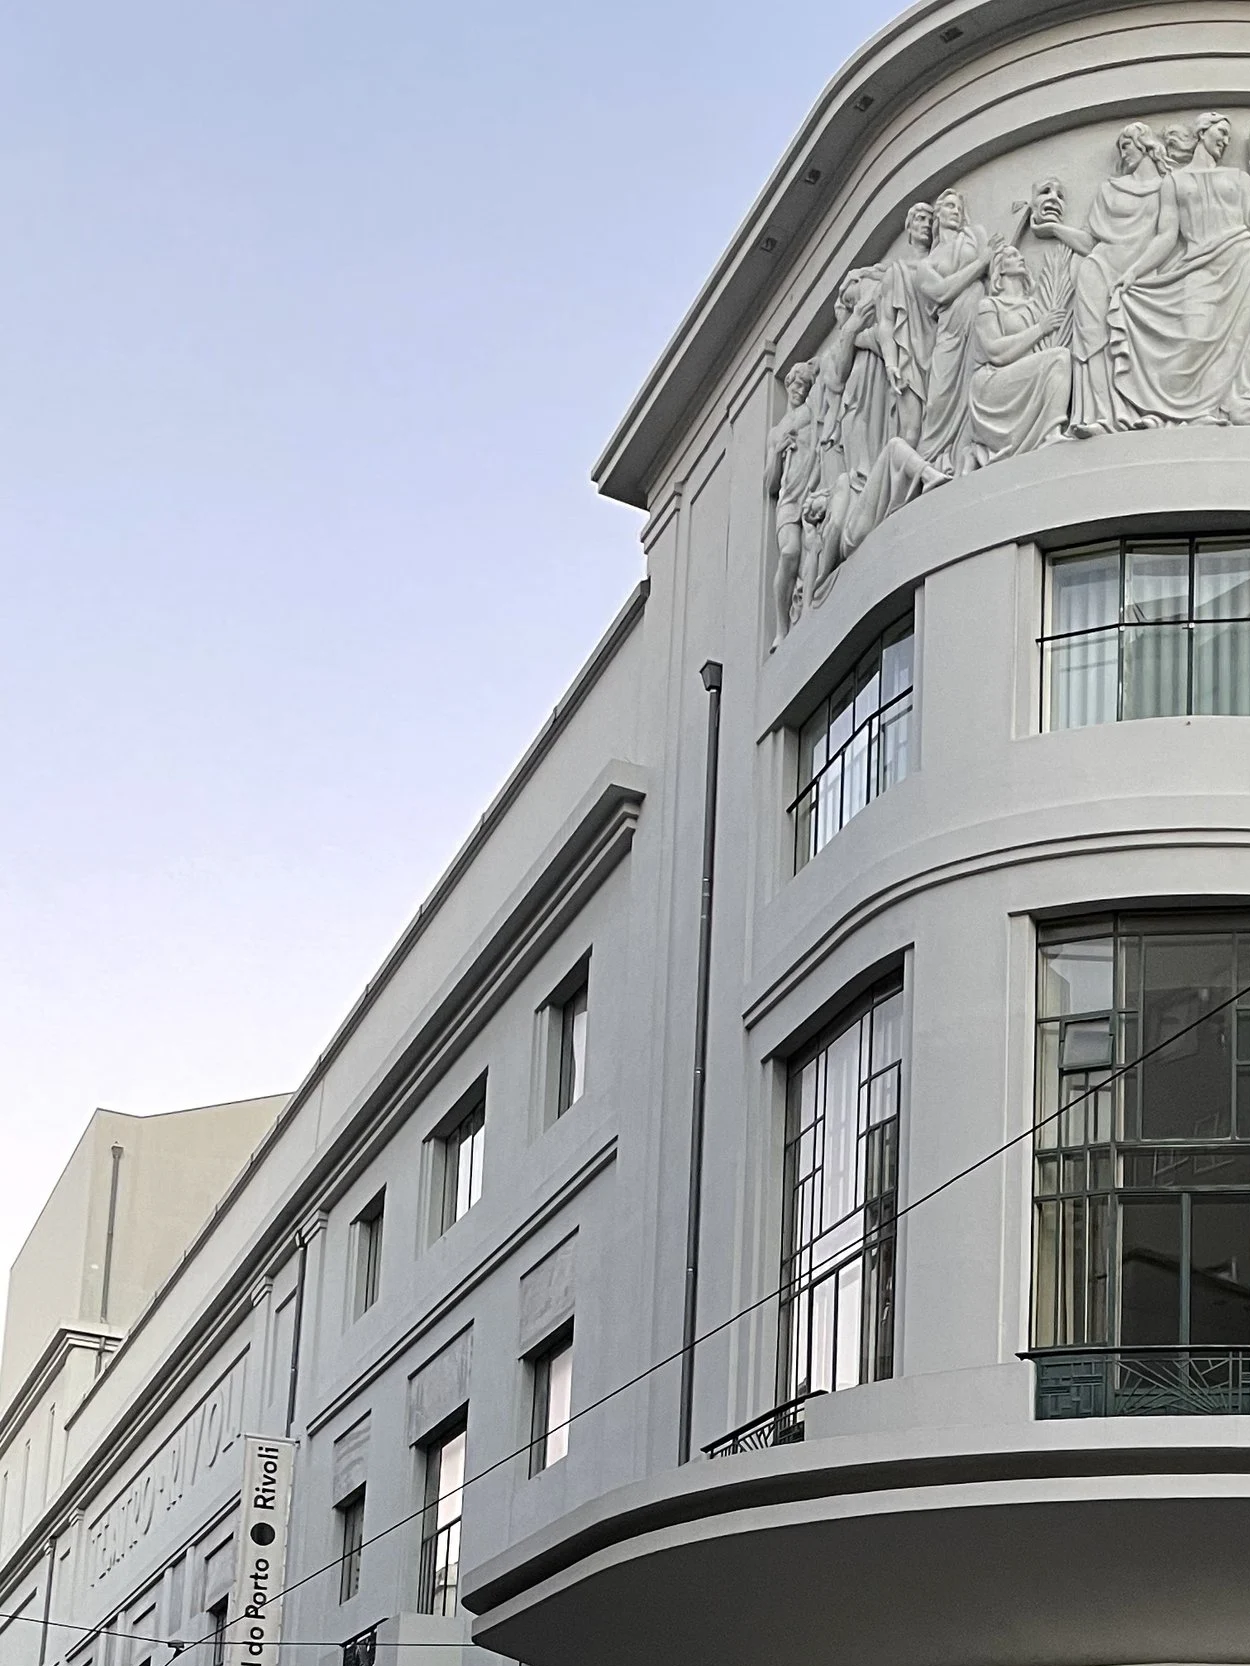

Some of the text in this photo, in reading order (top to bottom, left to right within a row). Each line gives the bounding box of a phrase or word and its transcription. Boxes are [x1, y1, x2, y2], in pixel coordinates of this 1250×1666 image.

[254, 1446, 279, 1510] Rivoli
[245, 1558, 269, 1617] Porto
[248, 1627, 264, 1656] do
